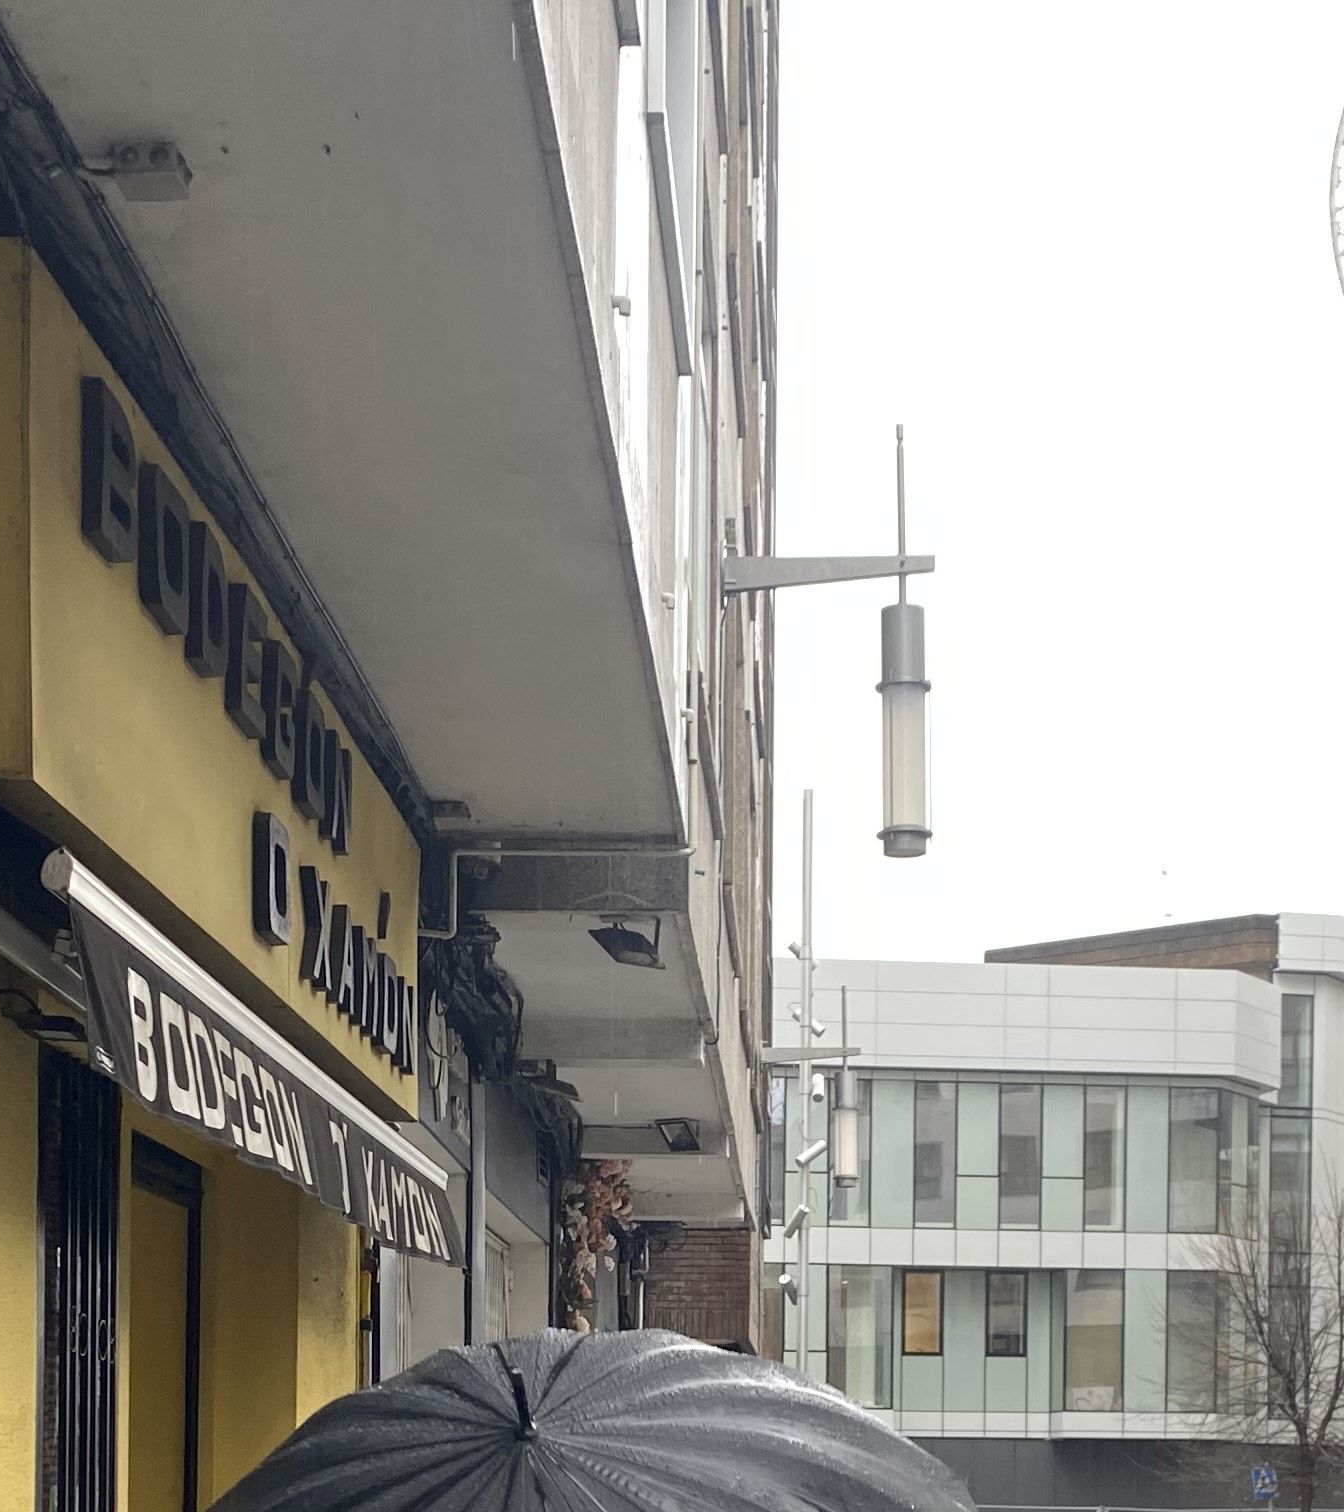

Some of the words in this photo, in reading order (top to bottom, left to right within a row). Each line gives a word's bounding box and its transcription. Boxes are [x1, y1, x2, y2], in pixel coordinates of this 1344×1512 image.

[253, 811, 291, 946] O
[299, 865, 415, 1076] XAMÓN
[127, 966, 314, 1187] BODEGON
[361, 1146, 451, 1261] XAMON
